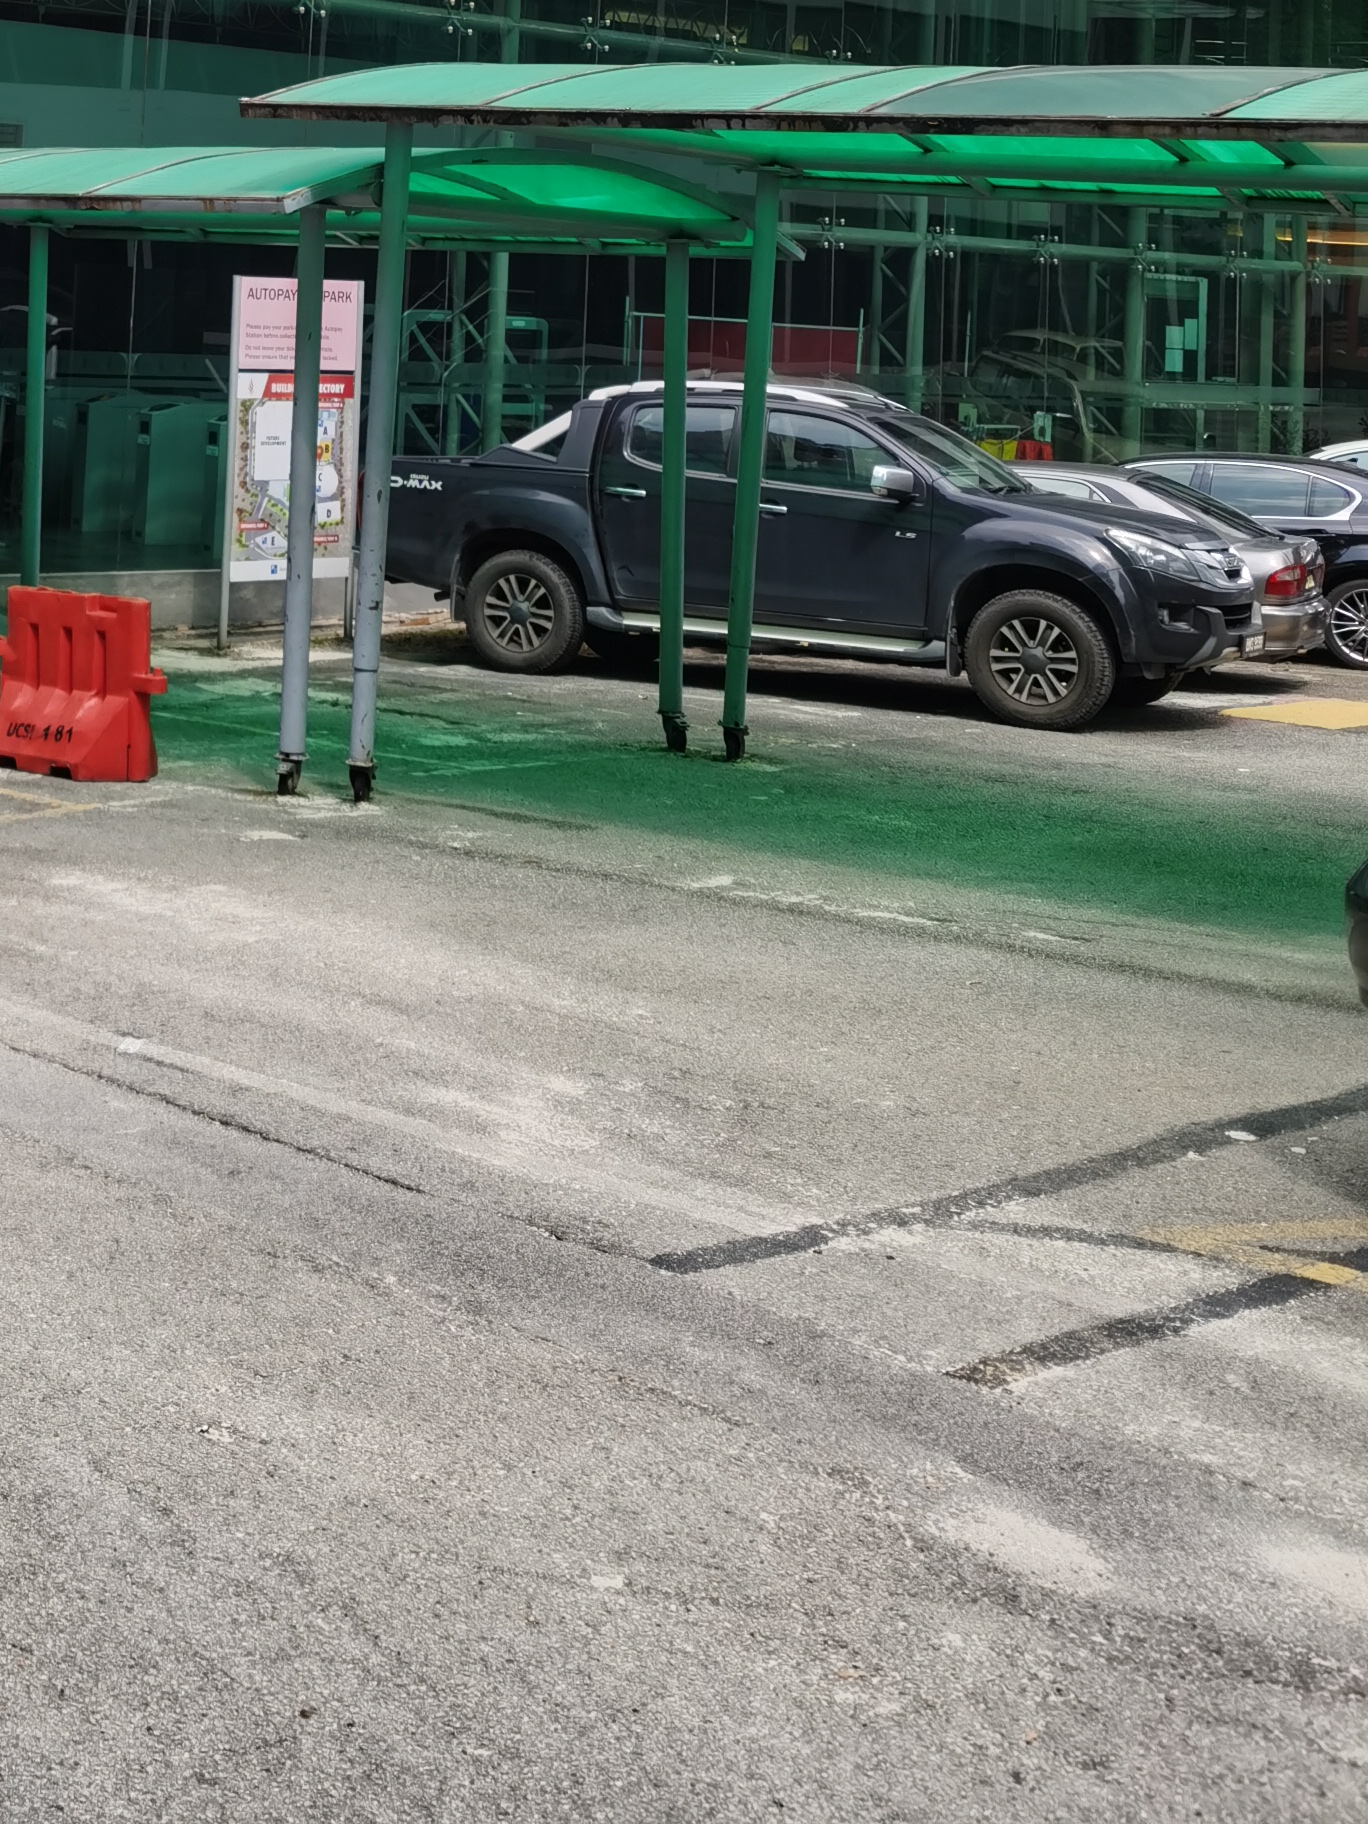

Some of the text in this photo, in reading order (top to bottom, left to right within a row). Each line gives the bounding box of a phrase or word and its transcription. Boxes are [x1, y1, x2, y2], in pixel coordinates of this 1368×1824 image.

[247, 287, 298, 302] AUTOPAY
[319, 383, 345, 394] ECTORY
[409, 473, 430, 481] ISUZU
[326, 509, 332, 518] D
[43, 724, 74, 744] 181
